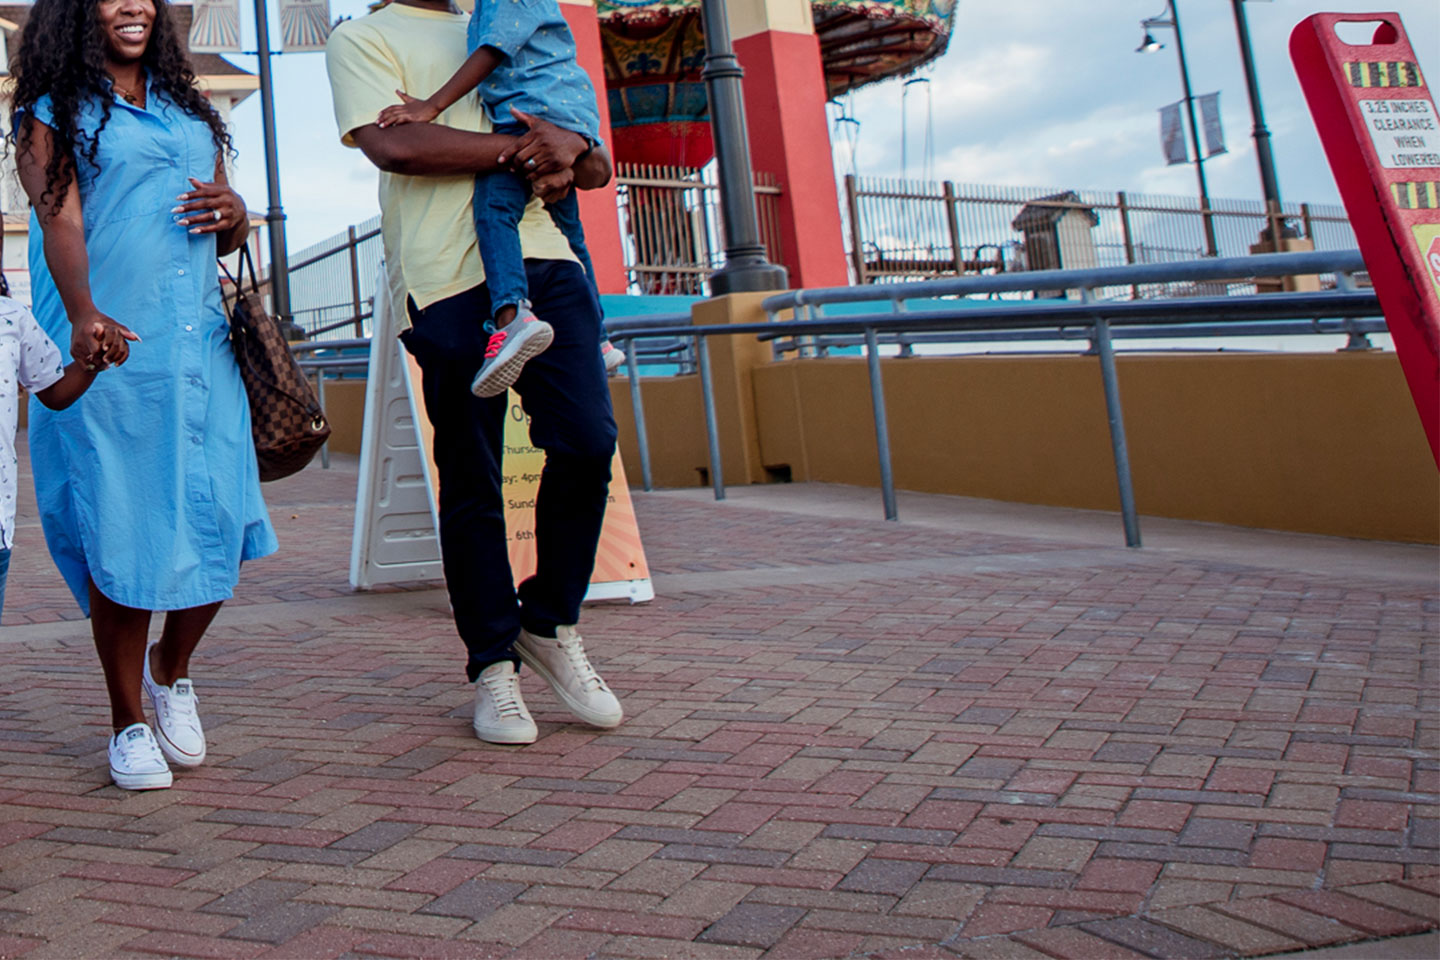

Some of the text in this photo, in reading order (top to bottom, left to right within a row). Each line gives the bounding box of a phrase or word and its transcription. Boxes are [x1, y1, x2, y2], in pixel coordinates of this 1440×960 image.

[1390, 100, 1429, 113] INCHES
[1373, 118, 1435, 131] CLEARANCE
[1393, 135, 1426, 148] WHEN
[1391, 152, 1440, 166] LOWERED
[516, 530, 534, 541] 6th
